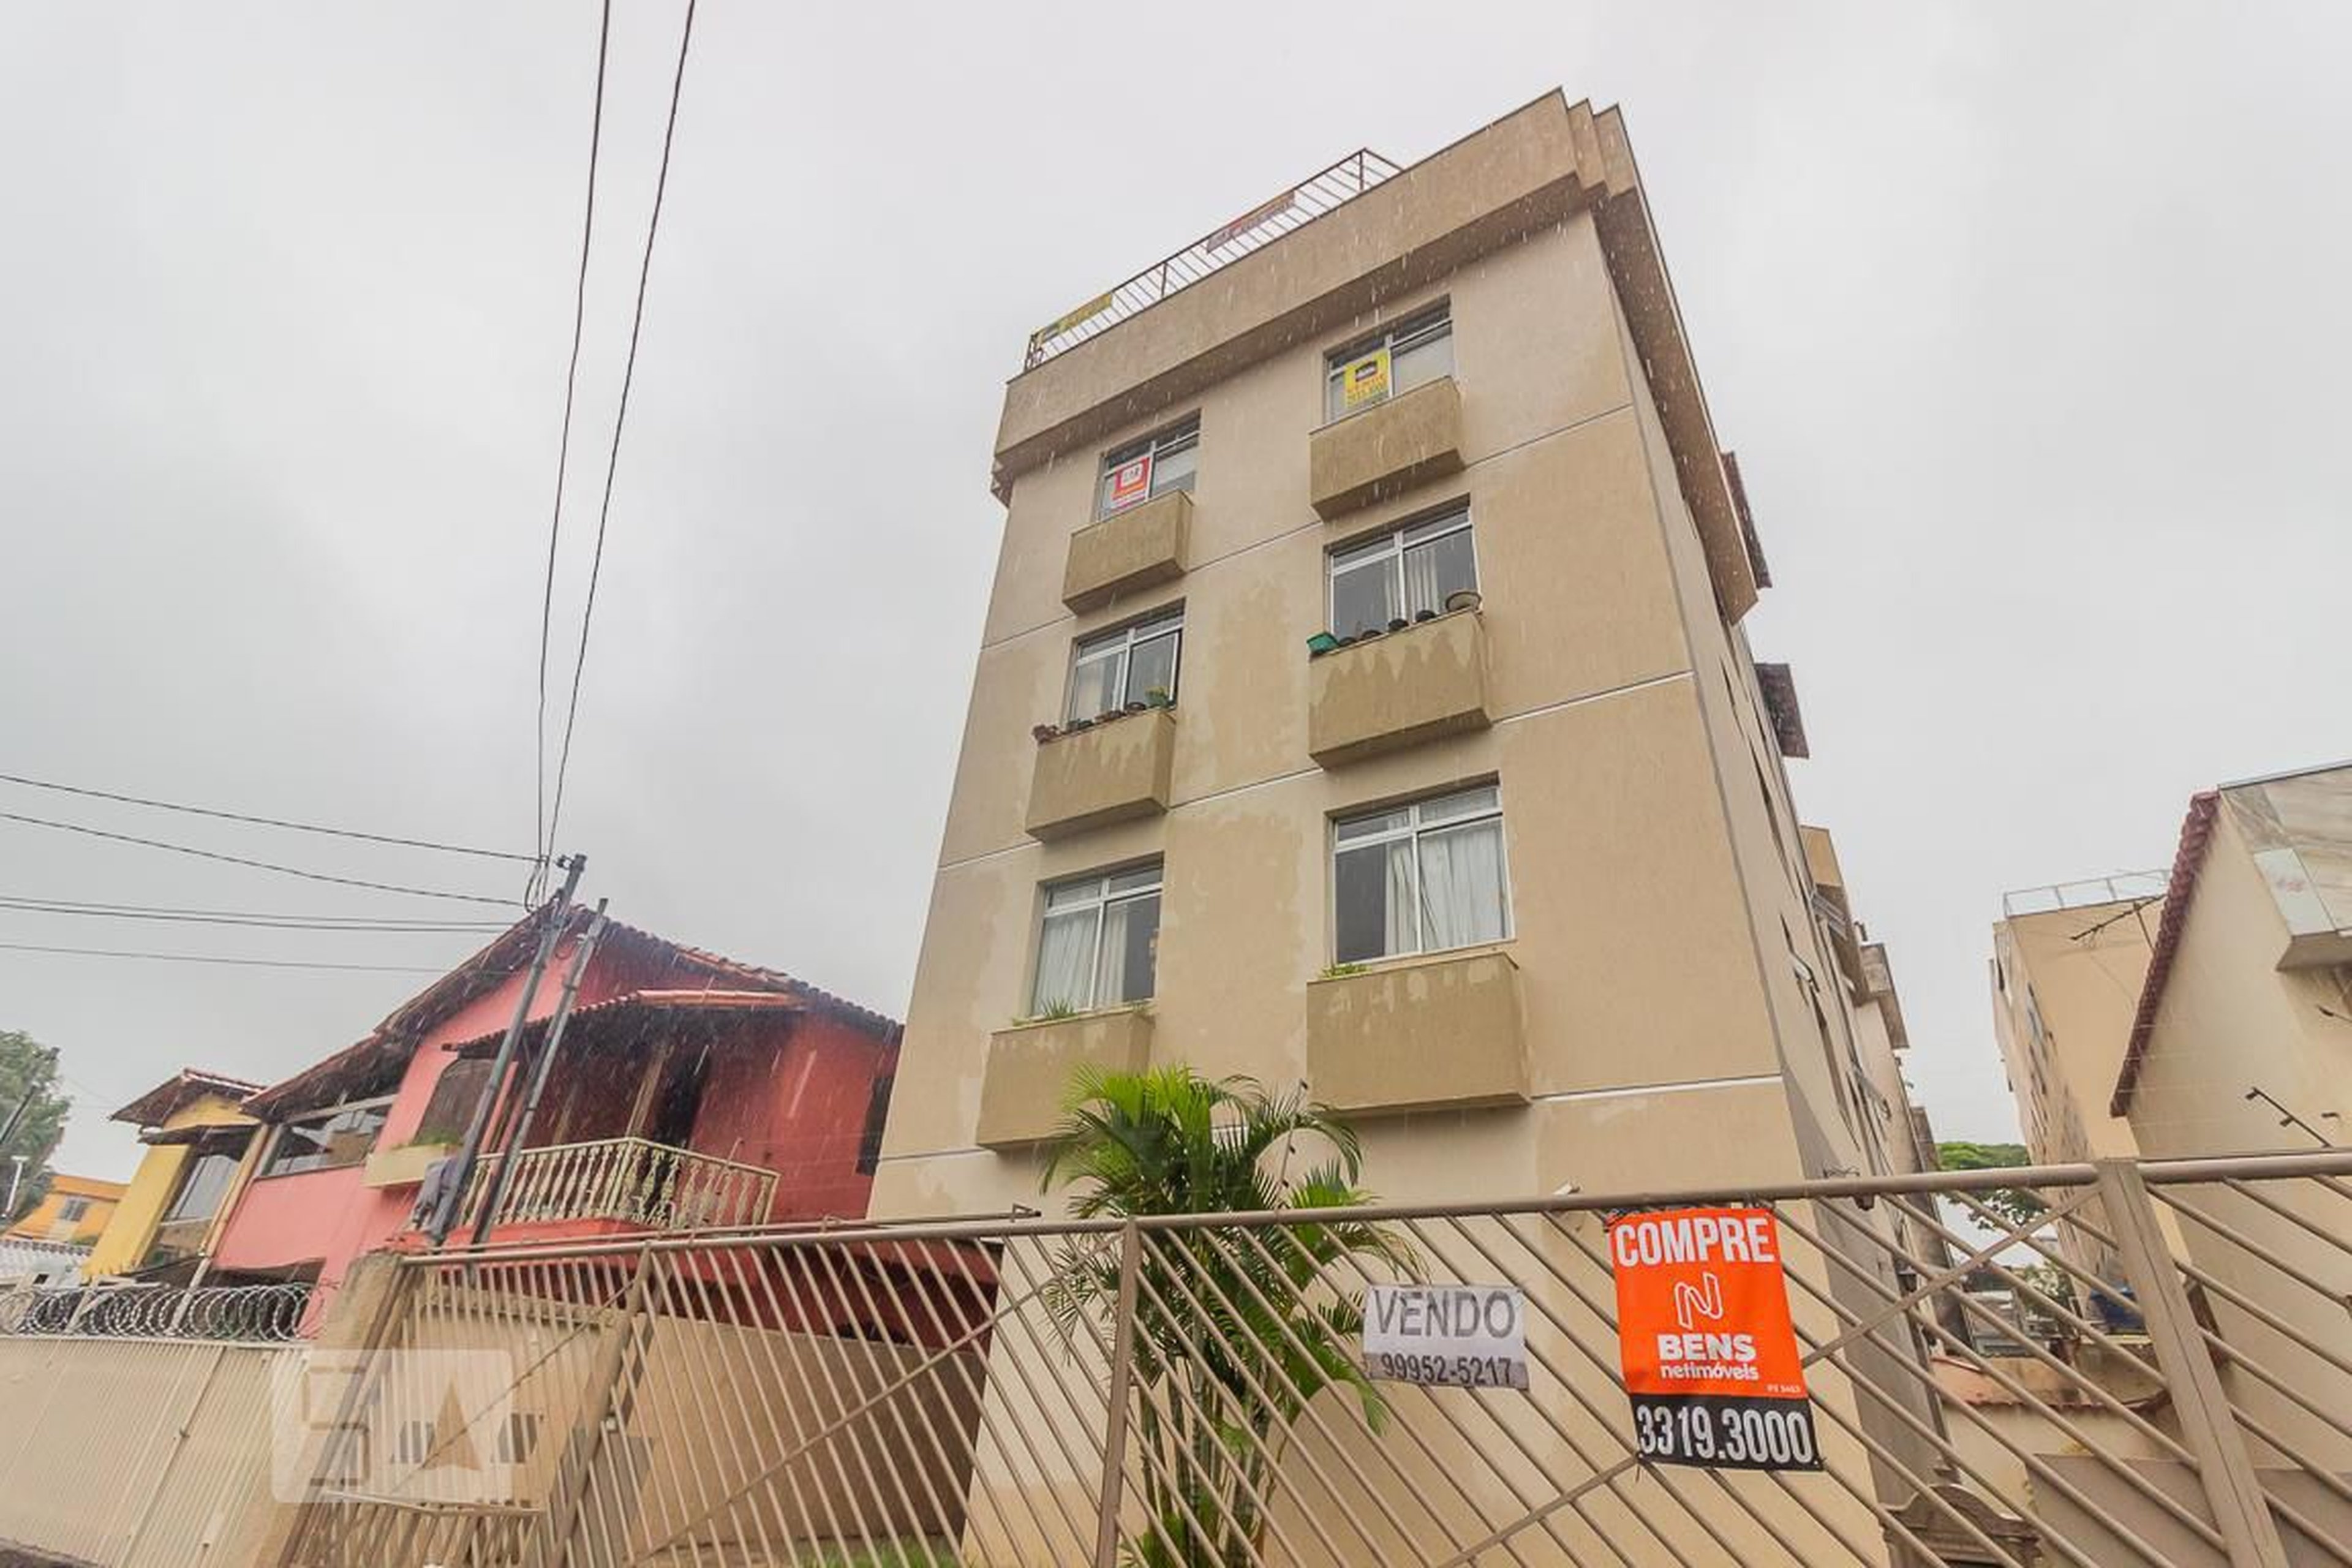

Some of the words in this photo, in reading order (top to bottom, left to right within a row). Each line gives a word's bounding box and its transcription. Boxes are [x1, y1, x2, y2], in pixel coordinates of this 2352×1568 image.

[1616, 1216, 1774, 1267] COMPRE
[1374, 1290, 1515, 1338] VENDO
[1381, 1352, 1511, 1384] 99952-5217
[1657, 1333, 1757, 1362] BENS
[1637, 1404, 1814, 1463] 3319.3000
